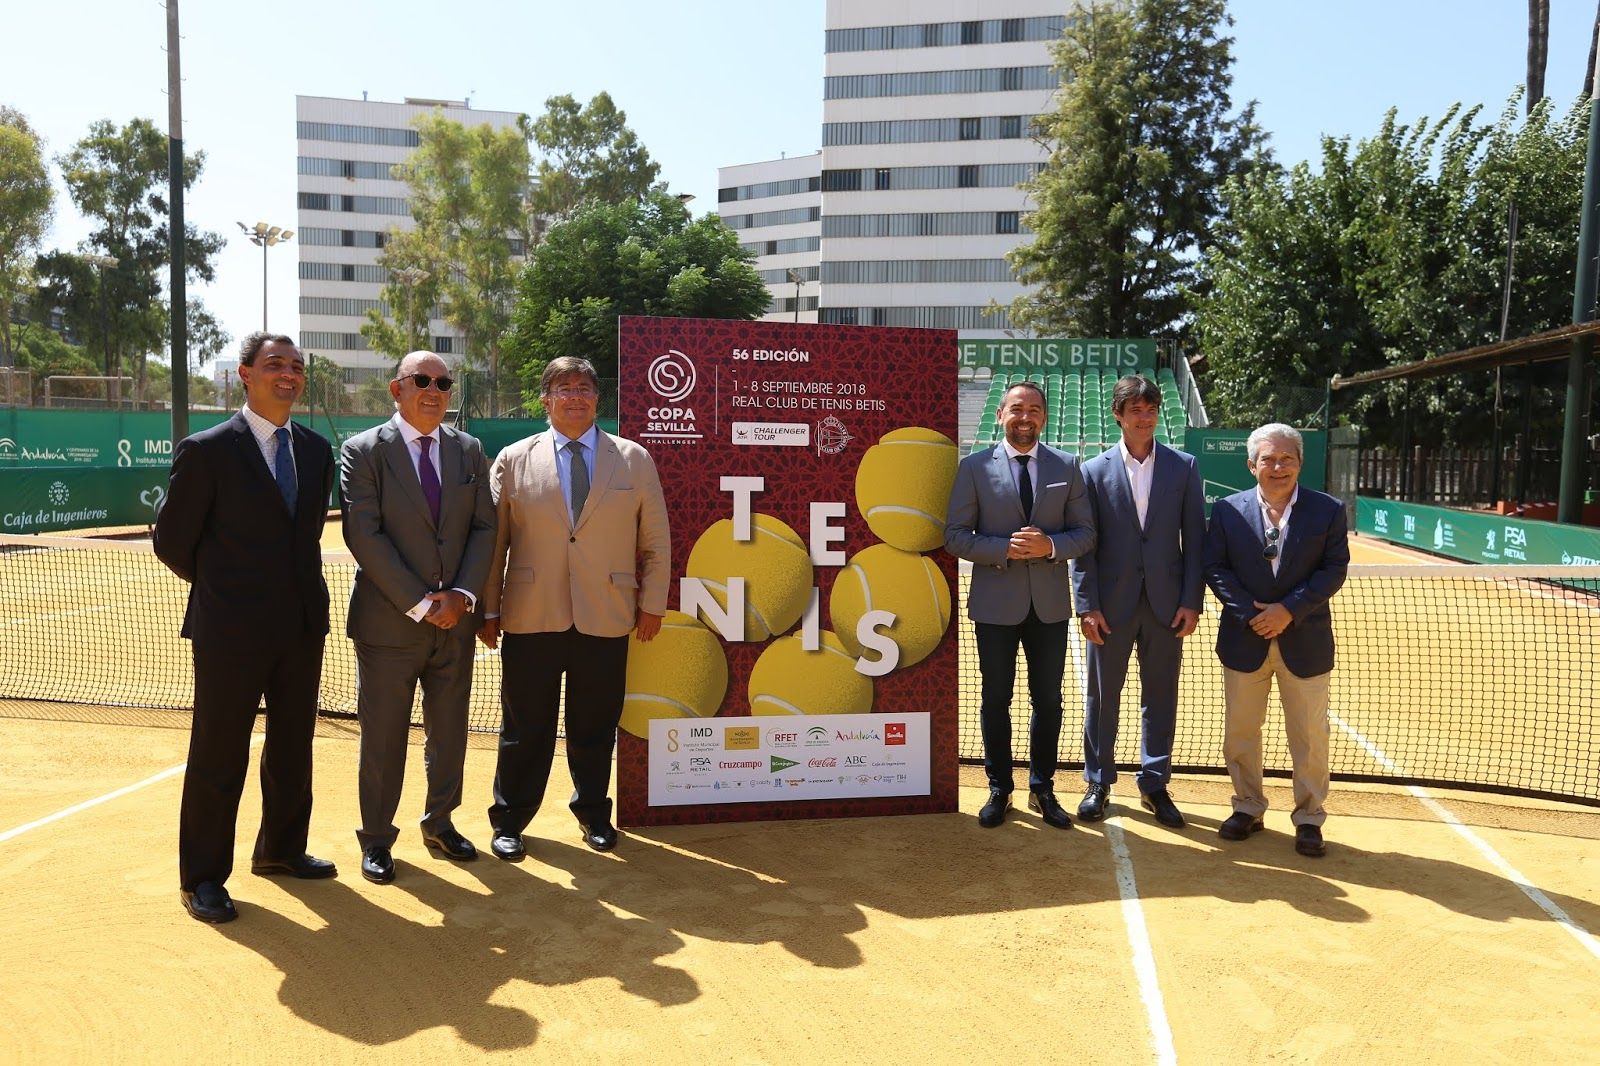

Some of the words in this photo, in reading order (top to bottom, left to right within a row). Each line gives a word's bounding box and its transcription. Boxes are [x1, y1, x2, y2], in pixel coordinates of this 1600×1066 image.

[732, 349, 749, 360] 56
[752, 348, 809, 362] EDICIÓN
[958, 344, 977, 366] E
[986, 344, 1059, 366] TENIS
[1070, 344, 1139, 367] BETIS
[732, 380, 738, 391] 1
[751, 381, 759, 392] 8
[762, 382, 833, 394] SEPTIEMBRE
[837, 384, 866, 395] 2018
[732, 396, 762, 407] REAL
[766, 397, 798, 409] CLUB
[801, 398, 818, 410] DE
[820, 399, 853, 410] TENIS
[856, 400, 886, 411] BETIS
[647, 407, 696, 420] COPA
[647, 422, 696, 432] SEVILLA
[753, 427, 806, 435] CHALLENGER
[20, 446, 68, 461] Andalucía
[144, 440, 173, 454] IMD
[4, 512, 32, 528] Caja
[35, 510, 50, 524] de
[52, 507, 108, 525] Ingenieros
[1374, 509, 1388, 527] ABC
[1504, 526, 1527, 546] PSA
[1504, 547, 1527, 561] RETAIL
[690, 727, 713, 738] IMD
[774, 733, 798, 742] RFET
[690, 757, 711, 766] PSA
[719, 760, 762, 770] Cruzcampo
[844, 755, 868, 765] ABC
